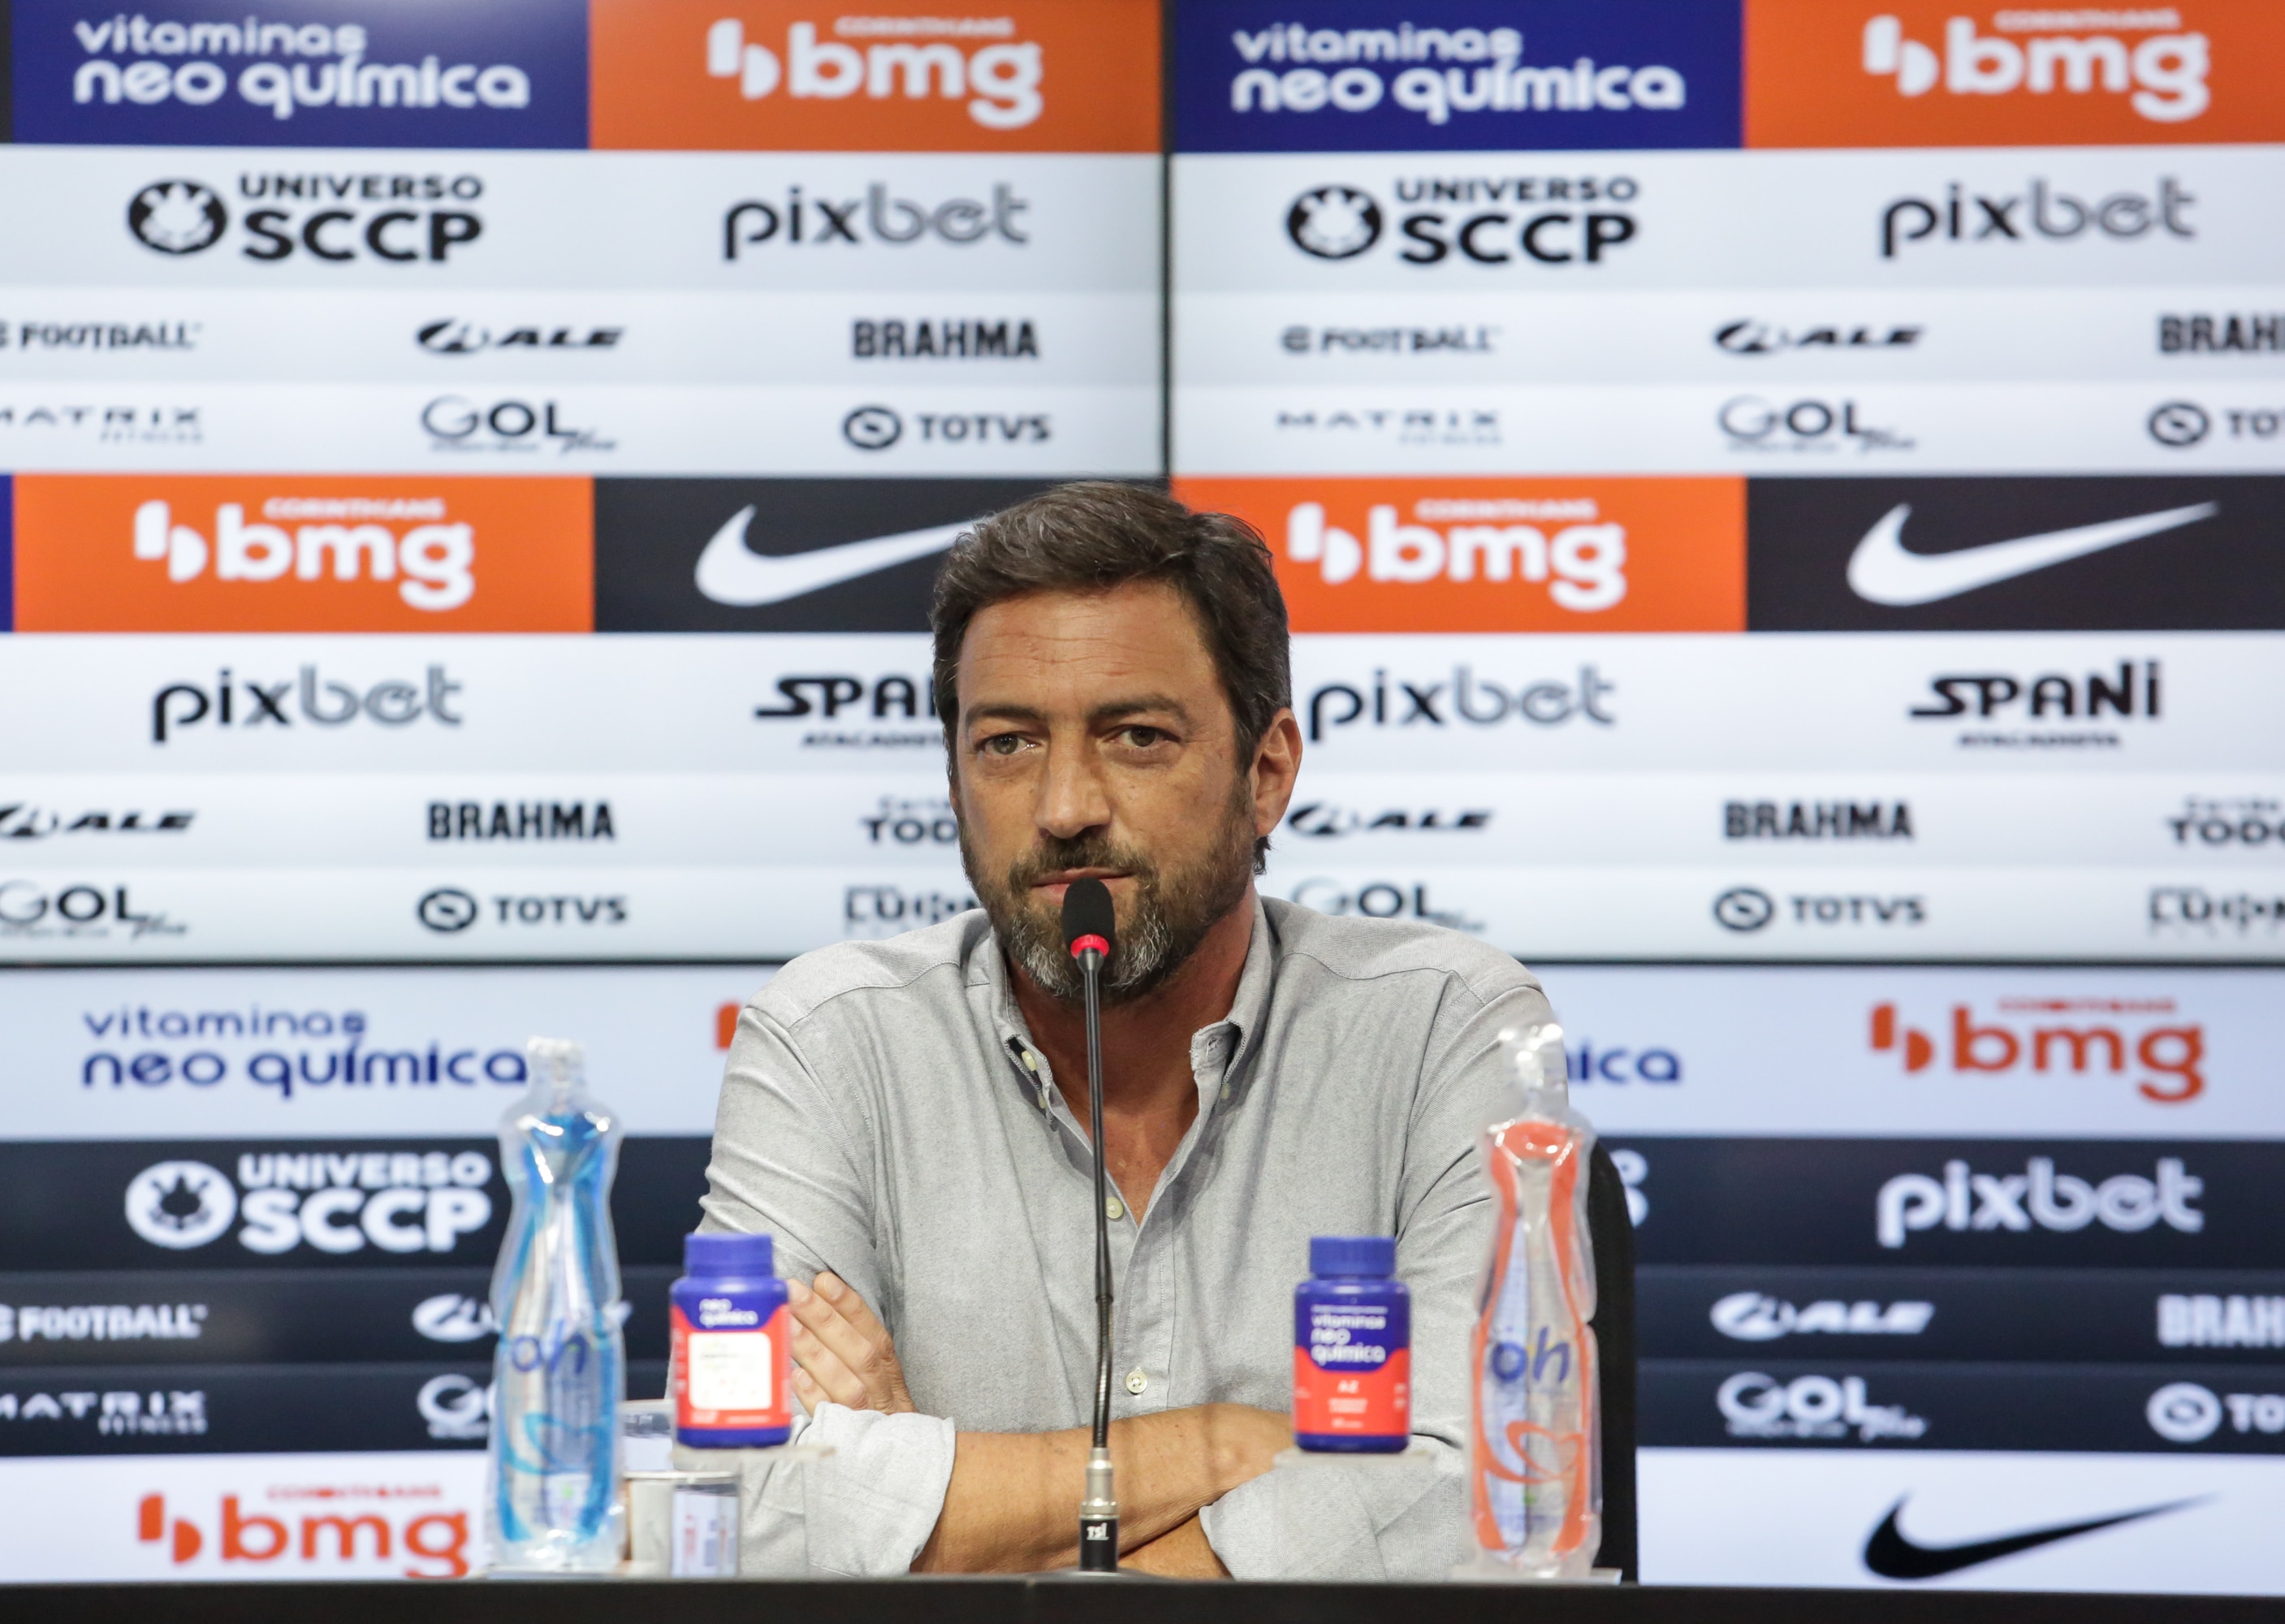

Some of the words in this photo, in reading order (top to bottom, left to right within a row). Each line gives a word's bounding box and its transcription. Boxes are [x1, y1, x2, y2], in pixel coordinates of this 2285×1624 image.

[75, 15, 368, 54] vitaminas
[1233, 22, 1523, 62] vitaminas
[75, 60, 227, 104] neo
[238, 55, 530, 119] química
[788, 21, 1043, 128] bmg
[1233, 68, 1384, 111] neo
[1392, 57, 1686, 125] química
[1946, 16, 2210, 122] bmg
[240, 175, 483, 200] UNIVERSO
[1396, 178, 1638, 203] UNIVERSO
[244, 209, 482, 262] SCCP
[724, 180, 1030, 261] pixbet
[1401, 213, 1636, 265] SCCP
[1881, 176, 2197, 259] pixbet
[853, 321, 1038, 358] BRAHMA
[2159, 315, 2285, 354] BRAH
[421, 394, 570, 440] GOL
[920, 415, 1051, 443] TOTVS
[1276, 412, 1496, 428] MATRIX
[1717, 395, 1868, 440] GOL
[216, 503, 475, 611] bmg
[1368, 504, 1627, 613] bmg
[152, 664, 463, 745] pixbet
[1309, 664, 1616, 744] pixbet
[429, 803, 614, 840] BRAHMA
[1726, 803, 1912, 839] BRAHMA
[496, 897, 627, 923] TOTVS
[1792, 896, 1926, 924] TOTVS
[84, 1005, 367, 1039] vitaminas
[83, 1053, 227, 1086] neo
[247, 1041, 528, 1099] química
[1952, 1004, 2205, 1104] bmg
[239, 1151, 491, 1186] UNIVERSO
[239, 1188, 491, 1253] SCCP
[1877, 1159, 2202, 1247] pixbet
[1717, 1372, 1872, 1426] GOL
[221, 1496, 469, 1578] bmg
